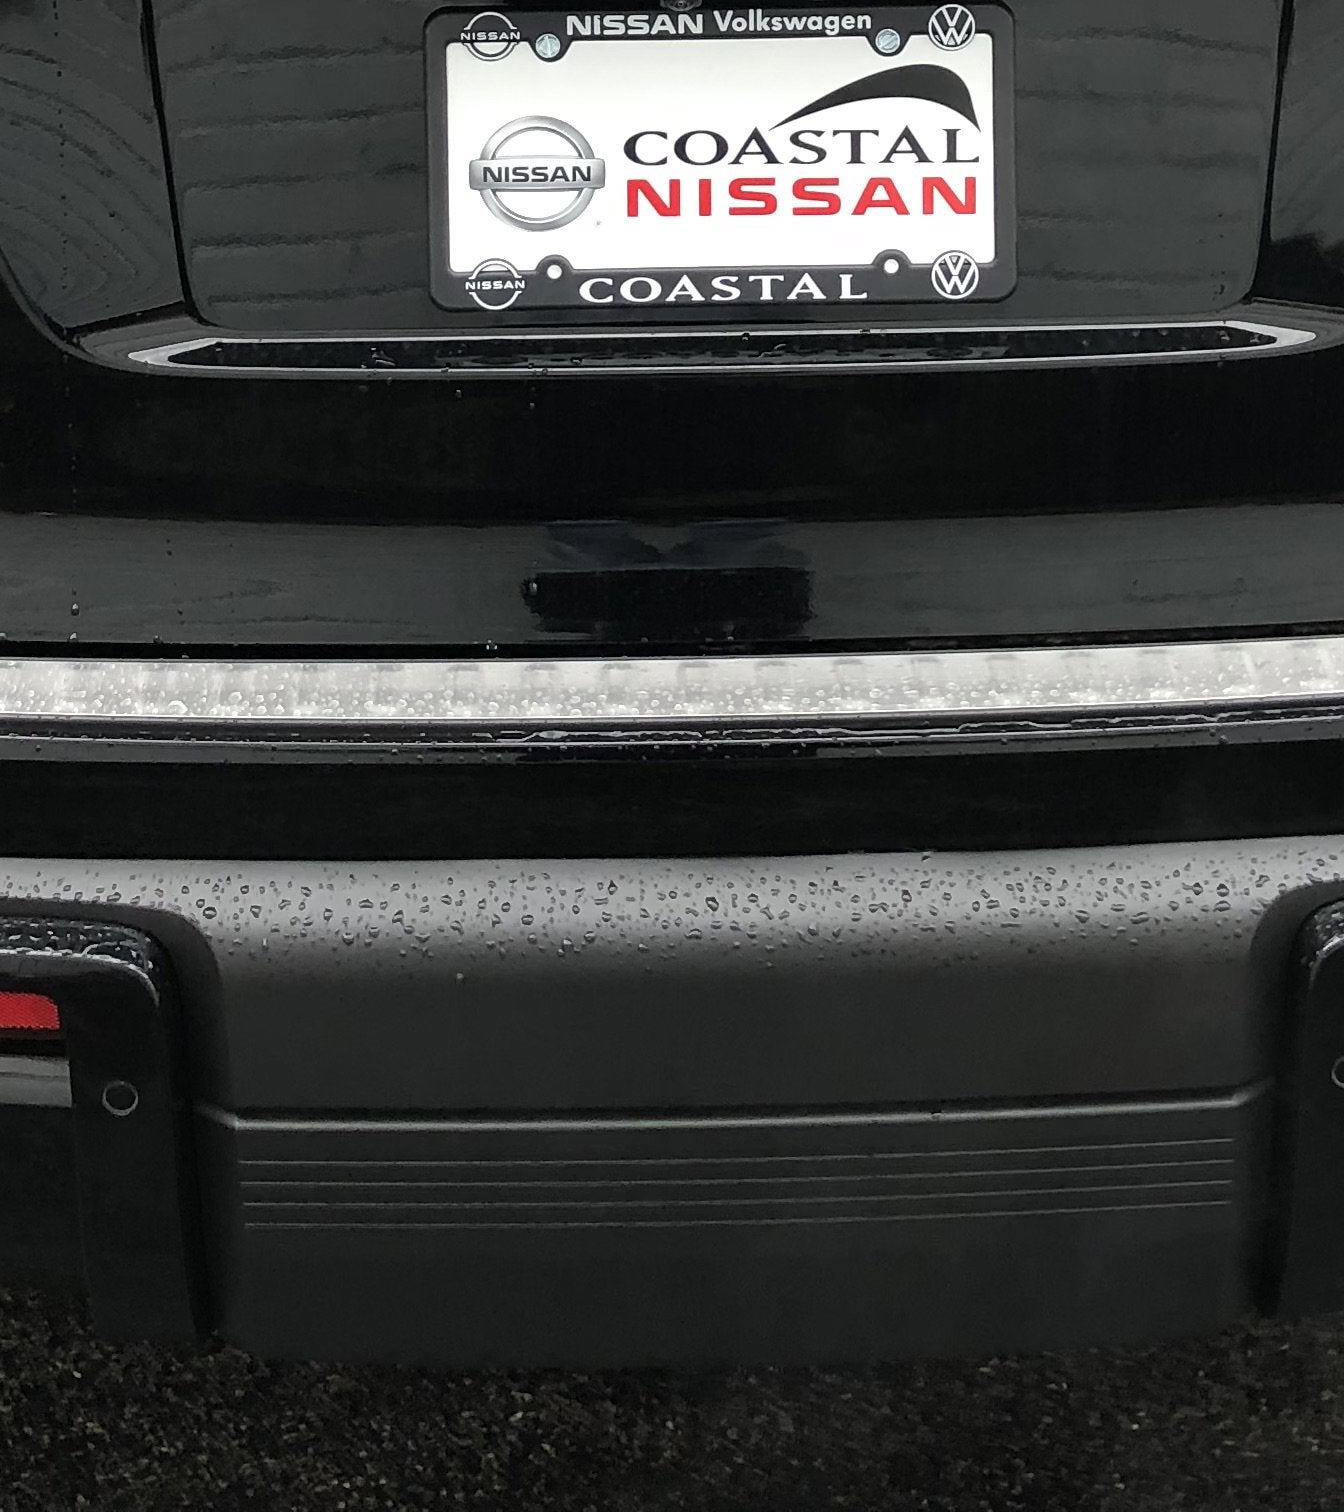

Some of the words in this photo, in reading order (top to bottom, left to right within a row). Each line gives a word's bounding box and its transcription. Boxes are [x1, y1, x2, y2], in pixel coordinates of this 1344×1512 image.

[460, 31, 521, 41] NISSAN
[566, 14, 704, 36] NISSAN
[713, 9, 872, 35] Volkswagen
[623, 124, 980, 166] COASTAL
[482, 164, 592, 184] NISSAN
[627, 176, 976, 217] NISSAN
[465, 280, 526, 290] NISSAN
[578, 272, 868, 303] COASTAL
